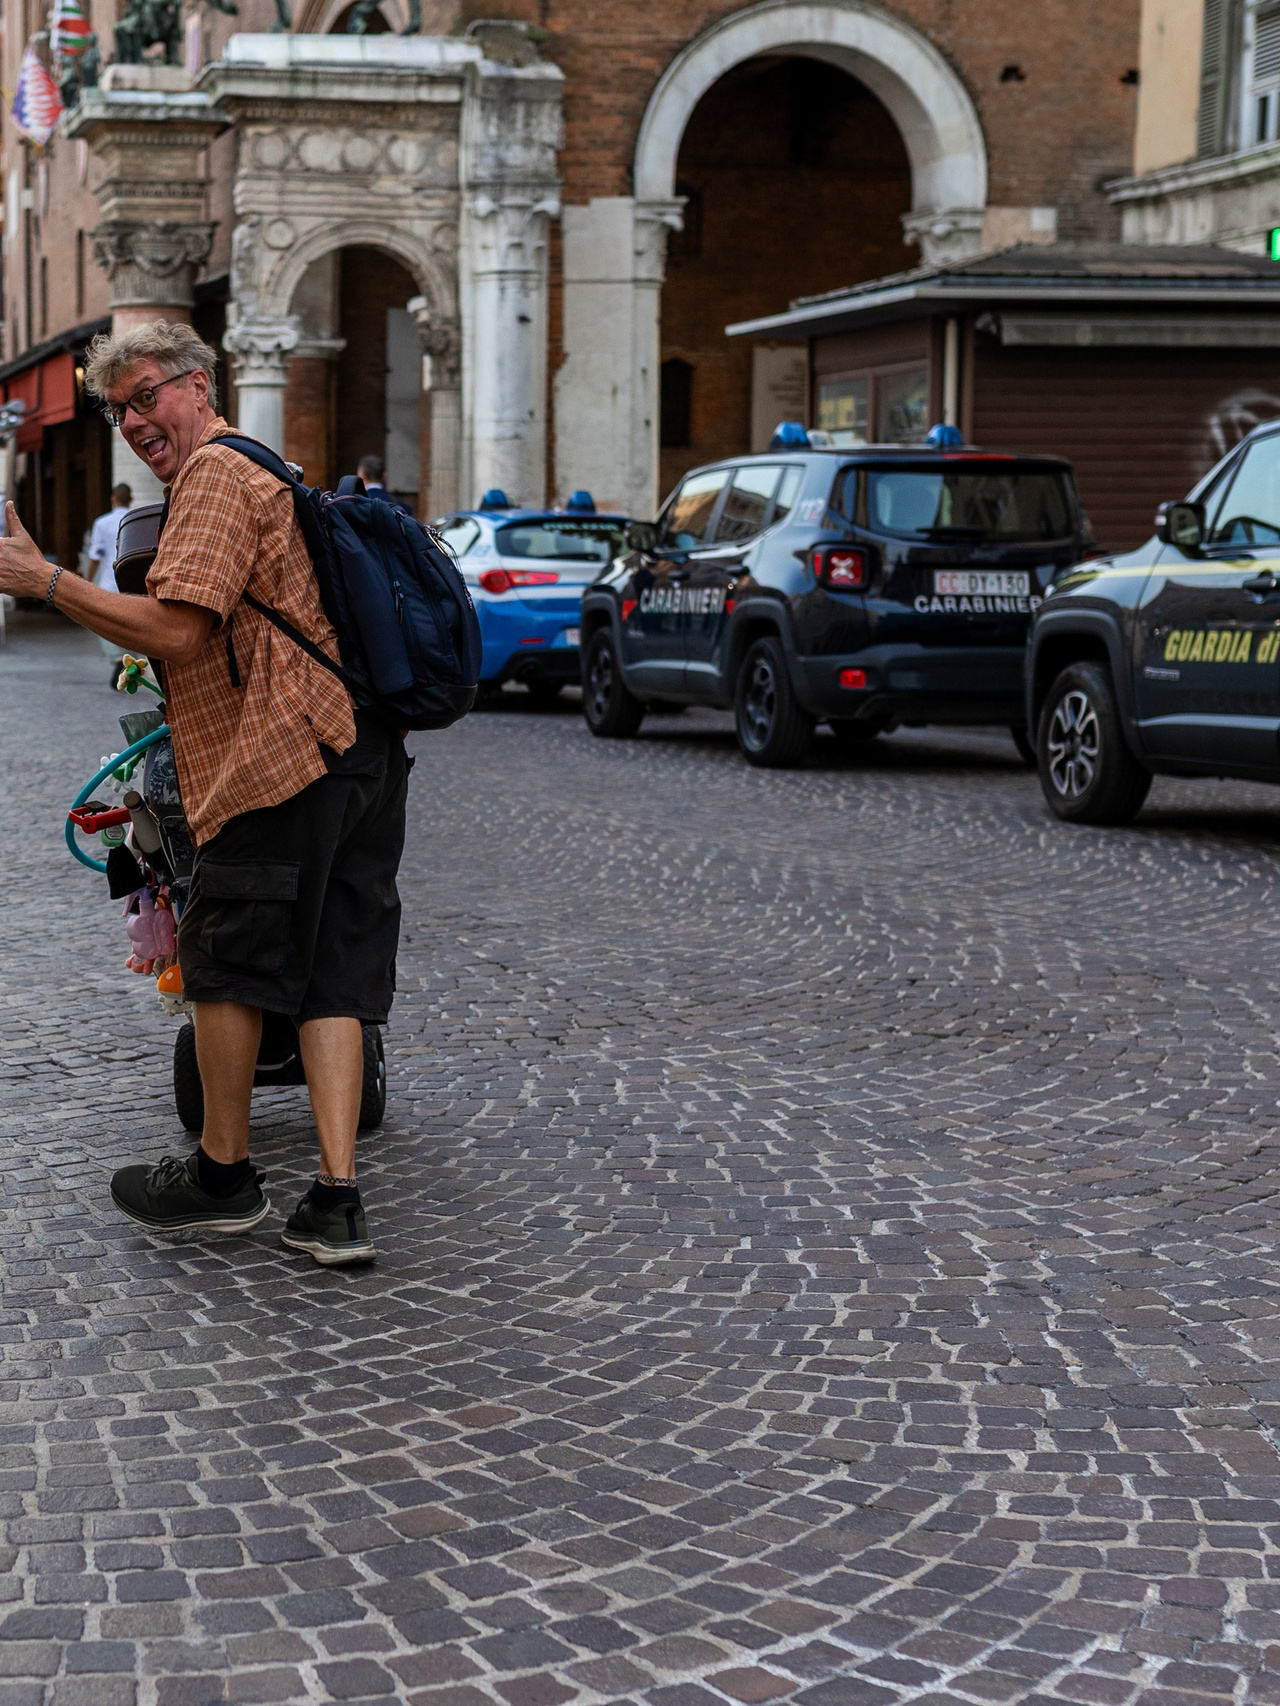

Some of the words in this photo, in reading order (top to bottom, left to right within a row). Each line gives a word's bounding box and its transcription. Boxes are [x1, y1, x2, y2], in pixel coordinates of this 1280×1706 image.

[938, 571, 959, 593] CC
[968, 573, 989, 593] DY
[640, 586, 728, 614] CARABINIERI
[1163, 629, 1253, 662] GUARDIA
[1255, 630, 1280, 663] di
